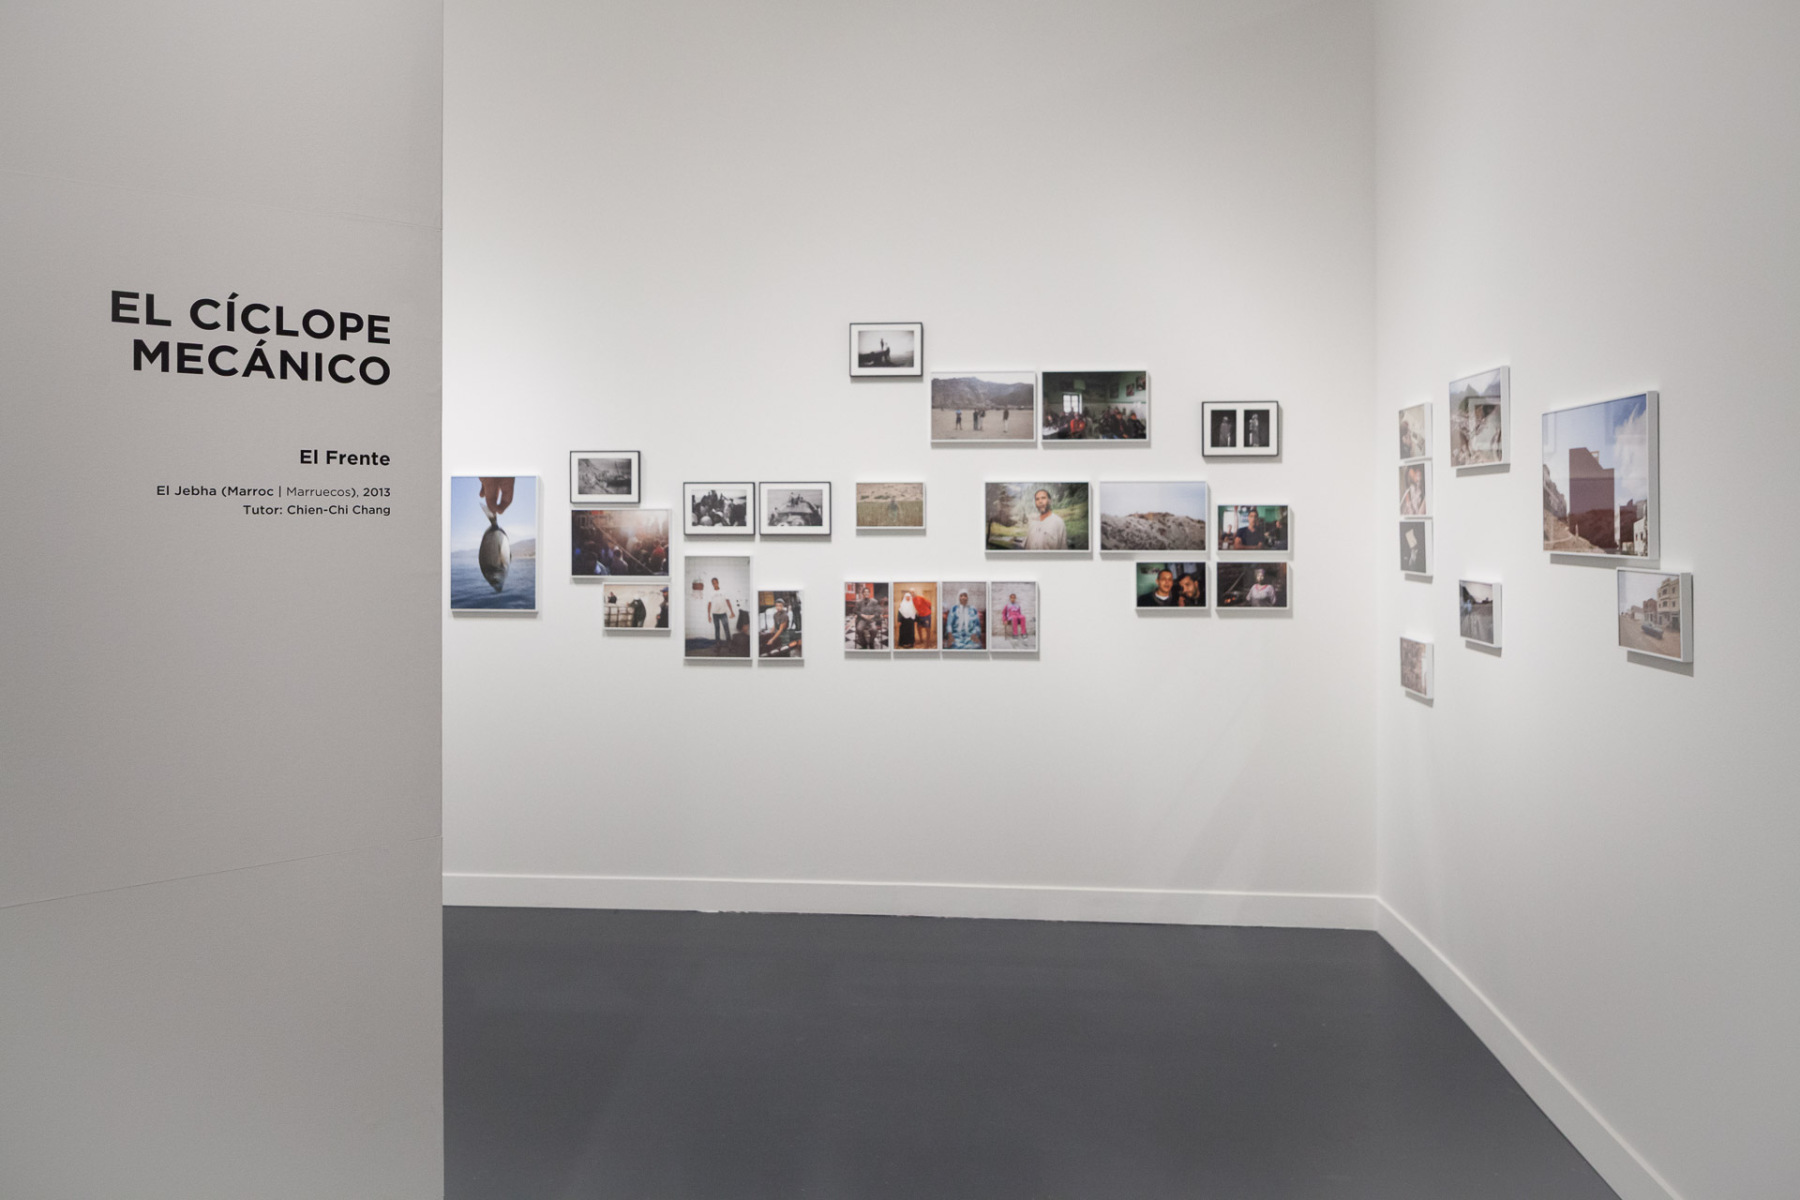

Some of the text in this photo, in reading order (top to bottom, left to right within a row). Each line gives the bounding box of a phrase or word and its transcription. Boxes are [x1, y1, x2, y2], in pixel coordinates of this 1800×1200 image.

[111, 290, 391, 345] EL CÍCLOPE
[133, 339, 391, 386] MECÁNICO
[300, 449, 391, 466] El Frente
[156, 485, 170, 497] El
[174, 485, 217, 497] Jebha
[221, 486, 275, 498] (Marroc
[286, 486, 360, 498] Marruecos),
[362, 487, 391, 498] 2013
[243, 504, 391, 517] Tutor: Chien-Chi Chang
